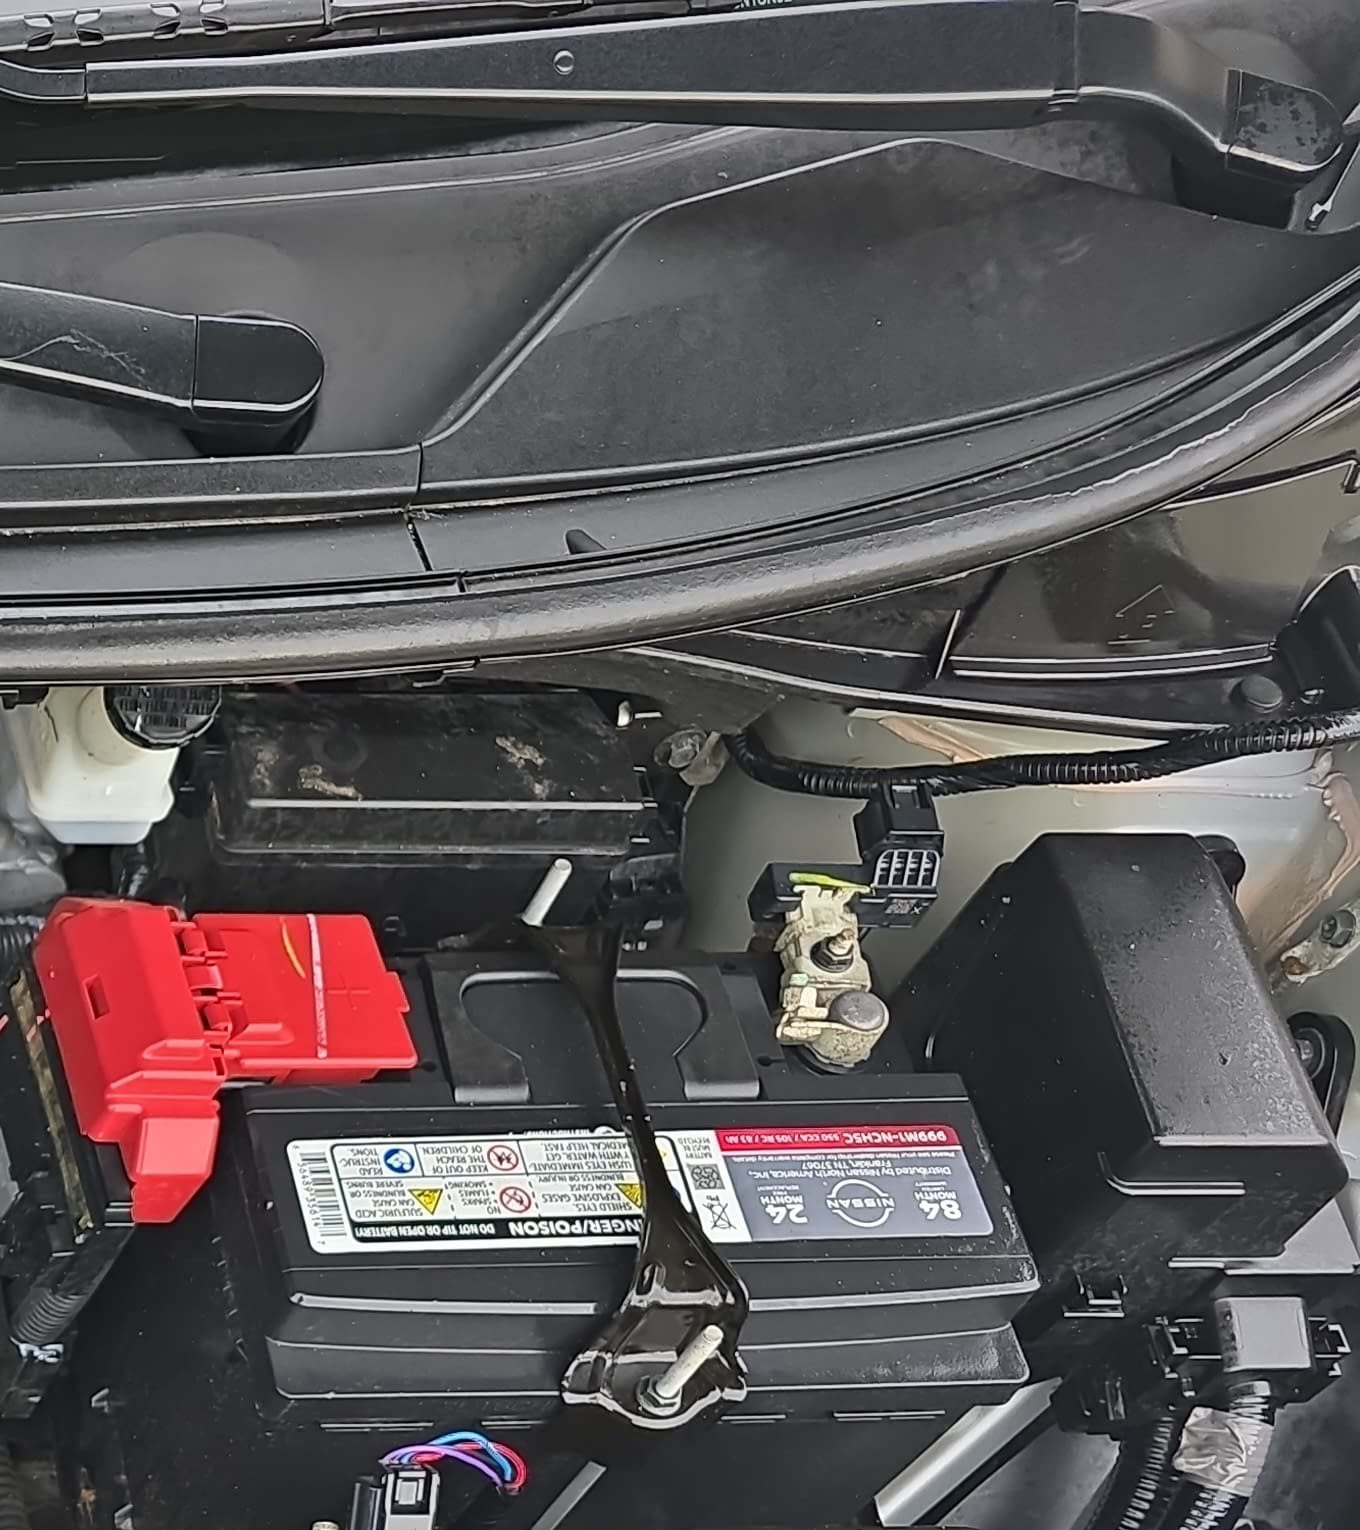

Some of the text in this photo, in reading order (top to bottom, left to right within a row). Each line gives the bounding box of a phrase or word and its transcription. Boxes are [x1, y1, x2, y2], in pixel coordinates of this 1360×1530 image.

[843, 1130, 947, 1143] 999M1-NCH5C
[566, 1143, 588, 1151] HELP
[436, 1156, 466, 1164] REACH
[545, 1153, 561, 1161] GET
[432, 1164, 488, 1174] KEEP OUT OF
[585, 1161, 606, 1170] EYES
[359, 1168, 383, 1176] READ
[815, 1170, 844, 1178] North
[846, 1168, 880, 1177] Nissan
[881, 1167, 894, 1176] by
[895, 1166, 952, 1176] Distributed
[568, 1174, 579, 1182] OR
[580, 1174, 624, 1182] BLINDNESS
[375, 1180, 403, 1188] SEVERE
[569, 1183, 612, 1192] CAN CAUSE
[348, 1190, 406, 1198] BLINDNESS OR
[542, 1192, 621, 1203] EXPLOSIVE GASES
[914, 1191, 957, 1200] MONTH
[372, 1199, 397, 1207] CAUSE
[760, 1194, 803, 1205] MONTH
[826, 1197, 896, 1209] NISSAN
[487, 1206, 501, 1215] NO
[600, 1202, 632, 1212] SHIELD
[918, 1200, 962, 1220] 84
[355, 1208, 424, 1218] SULFURIC ACID
[765, 1204, 808, 1224] 24
[398, 1226, 425, 1237] OPEN
[426, 1226, 440, 1236] OR
[442, 1225, 458, 1236] TIP
[459, 1224, 478, 1235] NOT
[480, 1224, 495, 1234] DO
